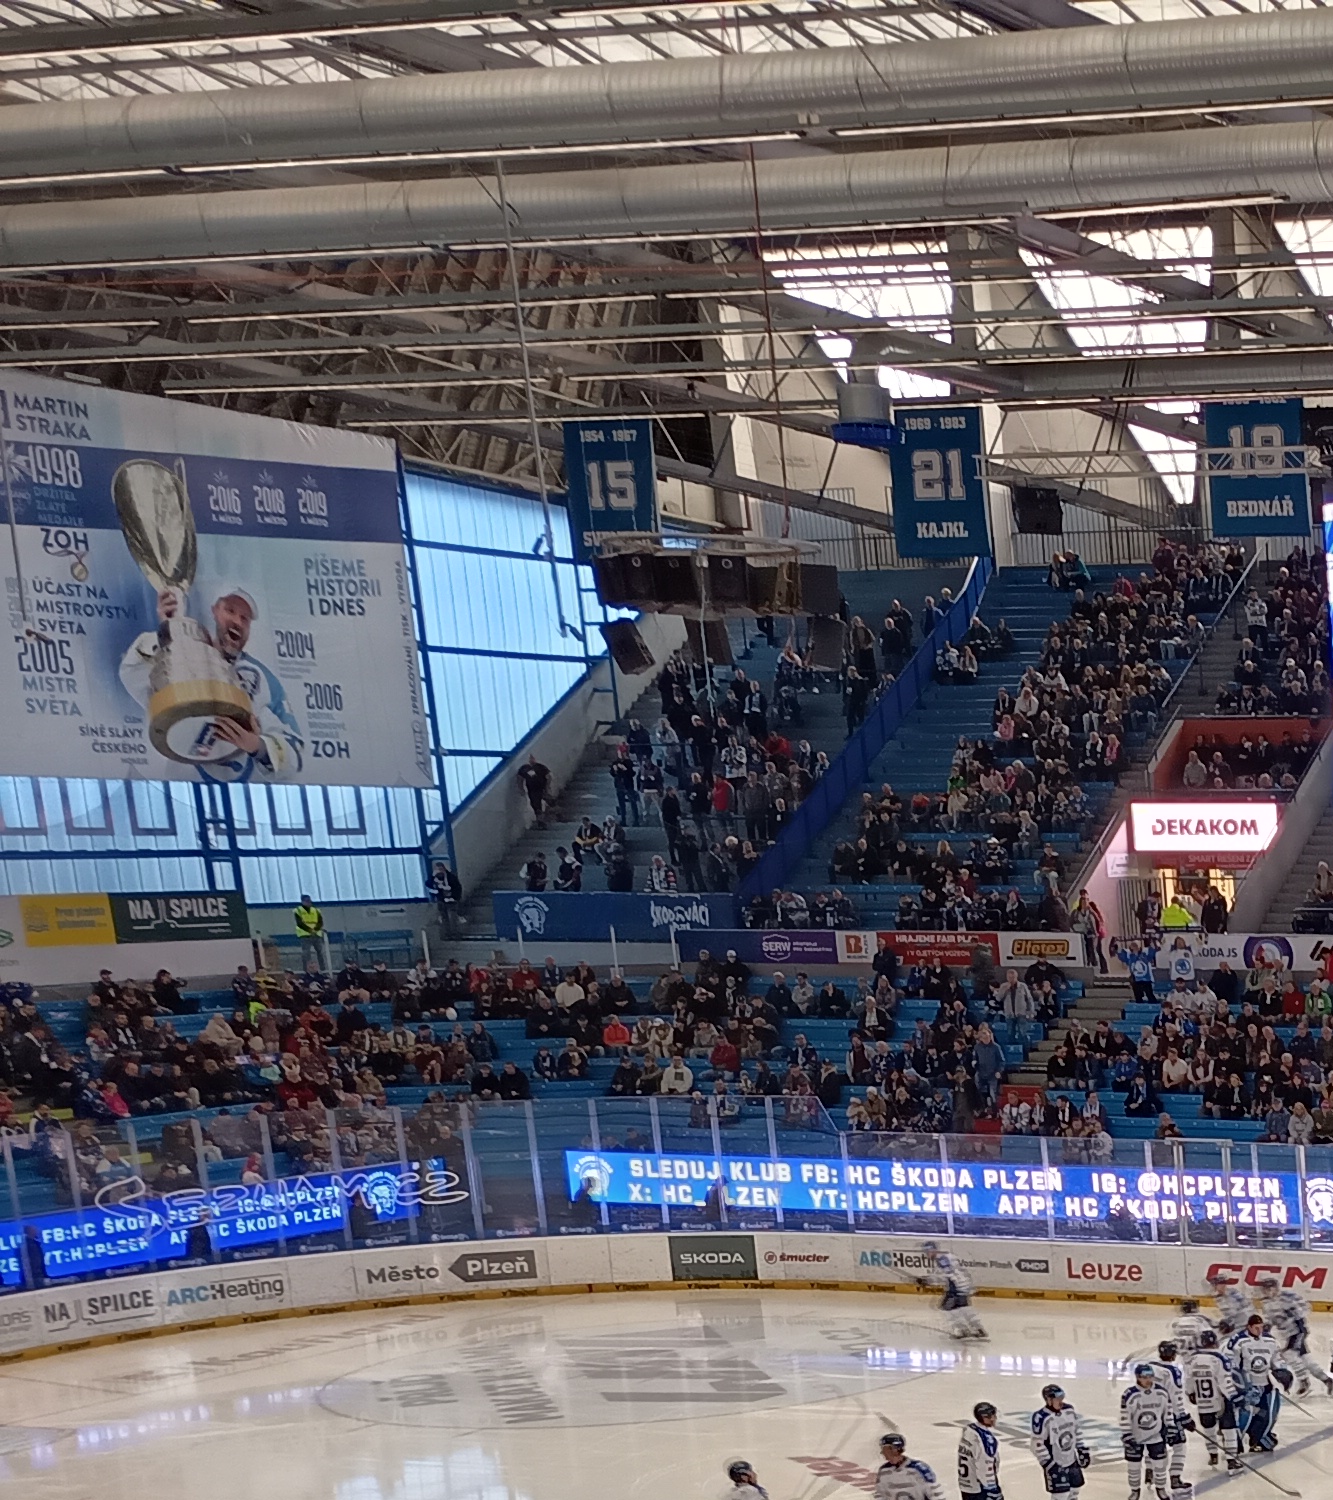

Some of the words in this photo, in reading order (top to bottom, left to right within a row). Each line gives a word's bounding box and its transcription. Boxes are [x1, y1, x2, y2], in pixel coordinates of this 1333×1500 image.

[13, 393, 89, 419] MARTIN
[15, 414, 91, 441] STRAKA
[28, 445, 83, 489] 1998
[911, 449, 967, 501] 21
[586, 460, 636, 511] 15
[207, 484, 241, 514] 2016
[253, 486, 285, 515] 2018
[296, 487, 328, 517] 2019
[1226, 494, 1294, 519] BEDNÁŘ
[40, 527, 90, 552] ZOH
[915, 521, 969, 539] KAJKL
[304, 553, 366, 577] PÍŠEME
[32, 576, 82, 598] ÚČAST
[86, 585, 109, 600] NA
[306, 578, 381, 597] HISTORII
[36, 599, 138, 620] MISTROVSTVÍ
[318, 599, 366, 617] DNES
[39, 615, 86, 636] SVĚTA
[14, 635, 75, 675] 2005
[275, 630, 316, 660] 2004
[22, 676, 78, 694] MISTR
[304, 682, 343, 711] 2006
[25, 695, 82, 717] SVĚTA
[109, 724, 143, 739] SLÁVY
[311, 740, 350, 759] ZOH
[1152, 818, 1259, 836] DEKAKOM
[127, 900, 155, 920] NA
[169, 897, 229, 919] SPILCE
[762, 940, 790, 952] SERW
[629, 1159, 720, 1180] SLEDUJ
[730, 1161, 792, 1182] KLUB
[801, 1164, 839, 1185] FB:
[849, 1165, 880, 1186] HC
[892, 1160, 974, 1189] ŠKODA
[984, 1168, 1063, 1191] PLZEŇ
[1092, 1172, 1126, 1194] IG:
[1138, 1172, 1280, 1199] @HCPLZEN
[629, 1184, 652, 1203] X:
[663, 1185, 780, 1208] HC_LZEN
[810, 1188, 848, 1209] YT:
[858, 1190, 969, 1213] HCPLZEN
[998, 1196, 1053, 1217] APP:
[1065, 1197, 1098, 1218] HC
[1207, 1199, 1288, 1226] PLZEŇ
[236, 1216, 289, 1235] ŠKODA
[294, 1204, 342, 1224] PLZEŇ
[366, 1264, 440, 1286] Město
[466, 1253, 531, 1276] Plzeň
[779, 1252, 830, 1265] šmucler
[1020, 1262, 1047, 1272] PMDP
[1067, 1257, 1143, 1282] Leuze
[1207, 1263, 1328, 1290] CCM
[44, 1302, 69, 1323] NA
[88, 1289, 154, 1315] SPILCE
[1194, 1378, 1213, 1399] 19
